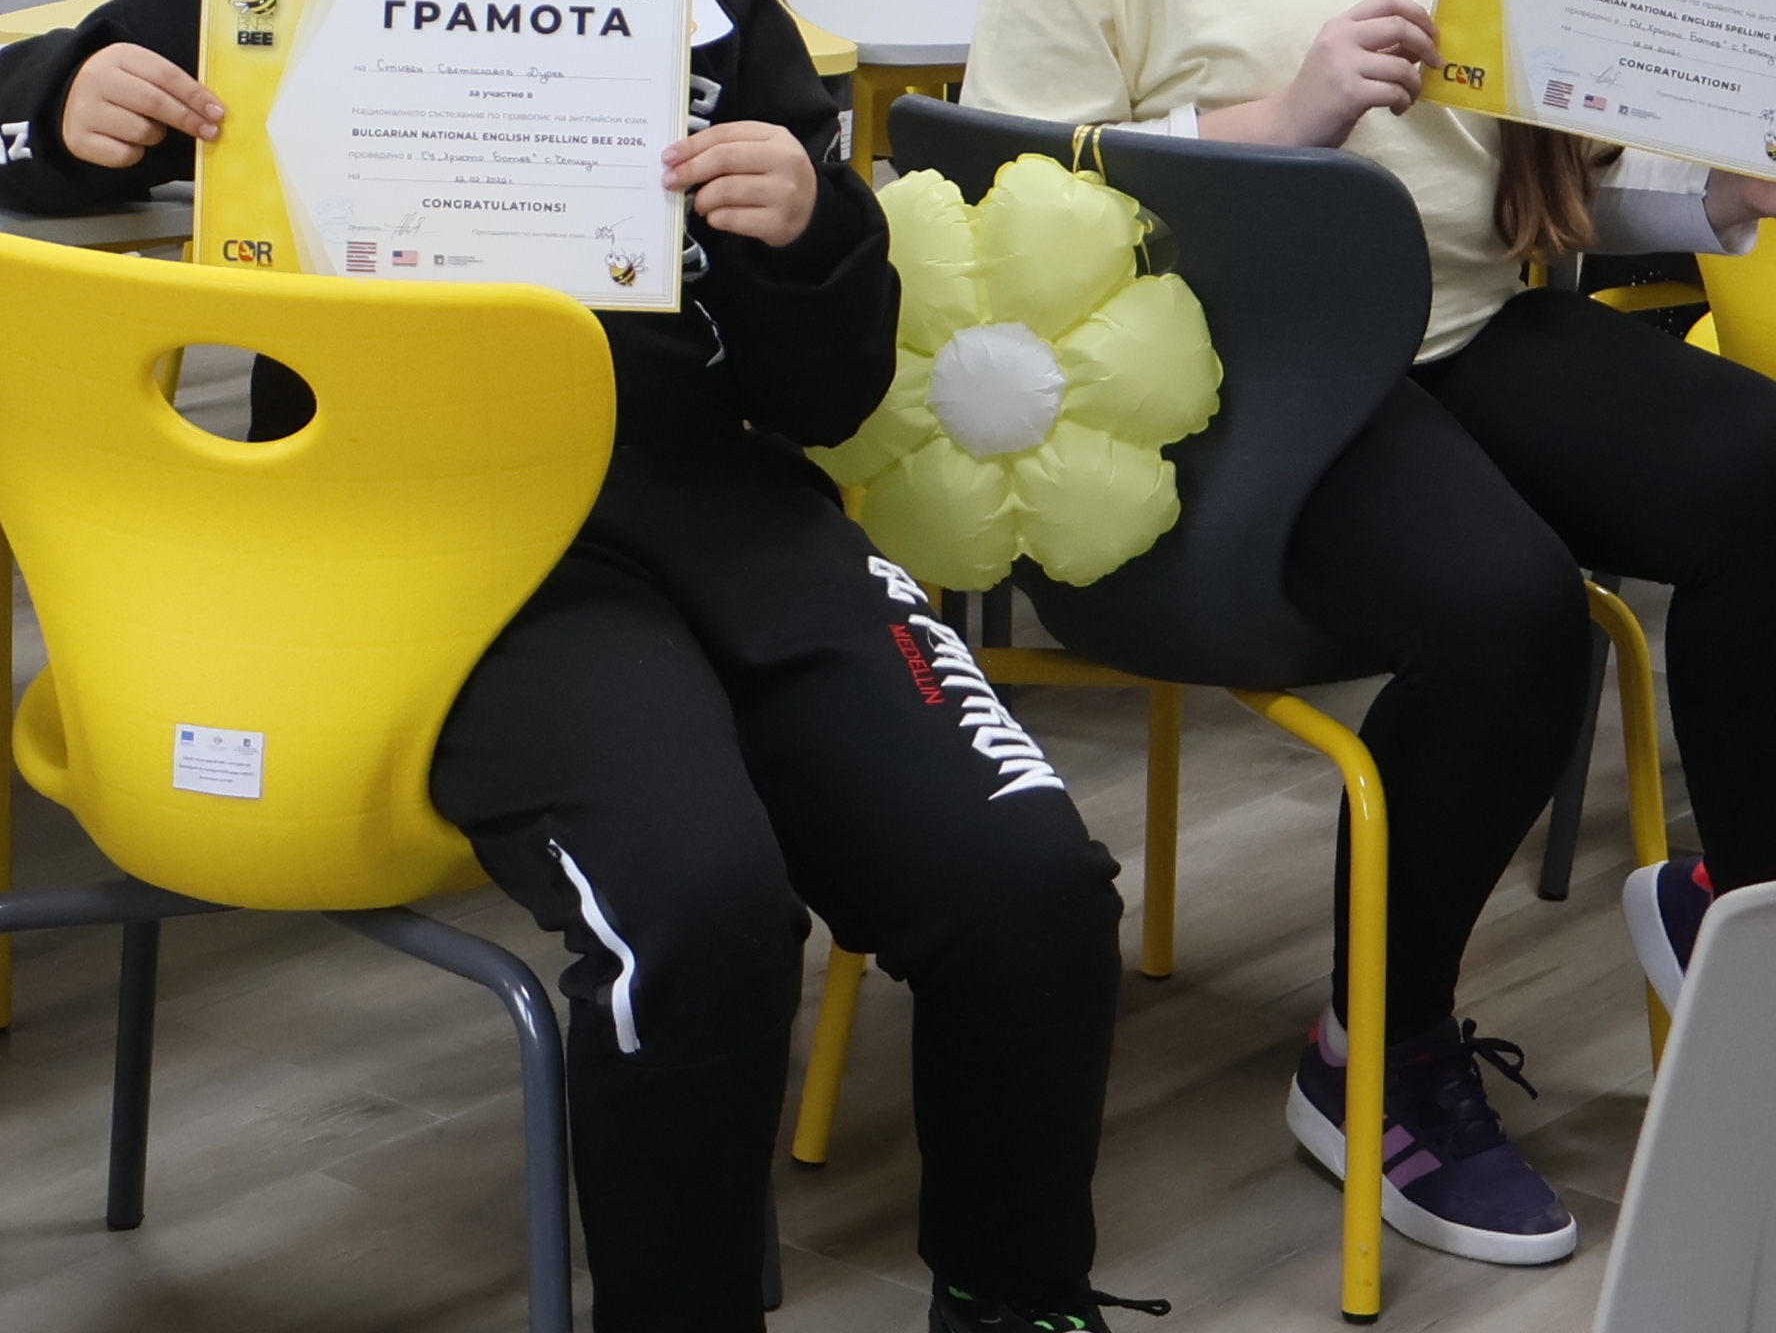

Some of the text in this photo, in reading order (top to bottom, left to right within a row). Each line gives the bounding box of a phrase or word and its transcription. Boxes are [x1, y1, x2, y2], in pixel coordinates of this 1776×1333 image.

[1629, 2, 1679, 20] NATIONAL
[1680, 13, 1722, 29] ENGLISH
[1724, 23, 1771, 40] SPELLING
[237, 30, 273, 45] BEE
[1618, 57, 1741, 92] CONGRATULATIONS!
[482, 90, 524, 100] участие
[352, 127, 417, 139] BULGARIAN
[421, 130, 478, 141] NATIONAL
[482, 132, 530, 142] ENGLISH
[534, 133, 588, 144] SPELLING
[591, 135, 613, 145] BEE
[422, 197, 566, 213] CONGRATULATIONS!
[888, 623, 946, 706] MEDELLIN
